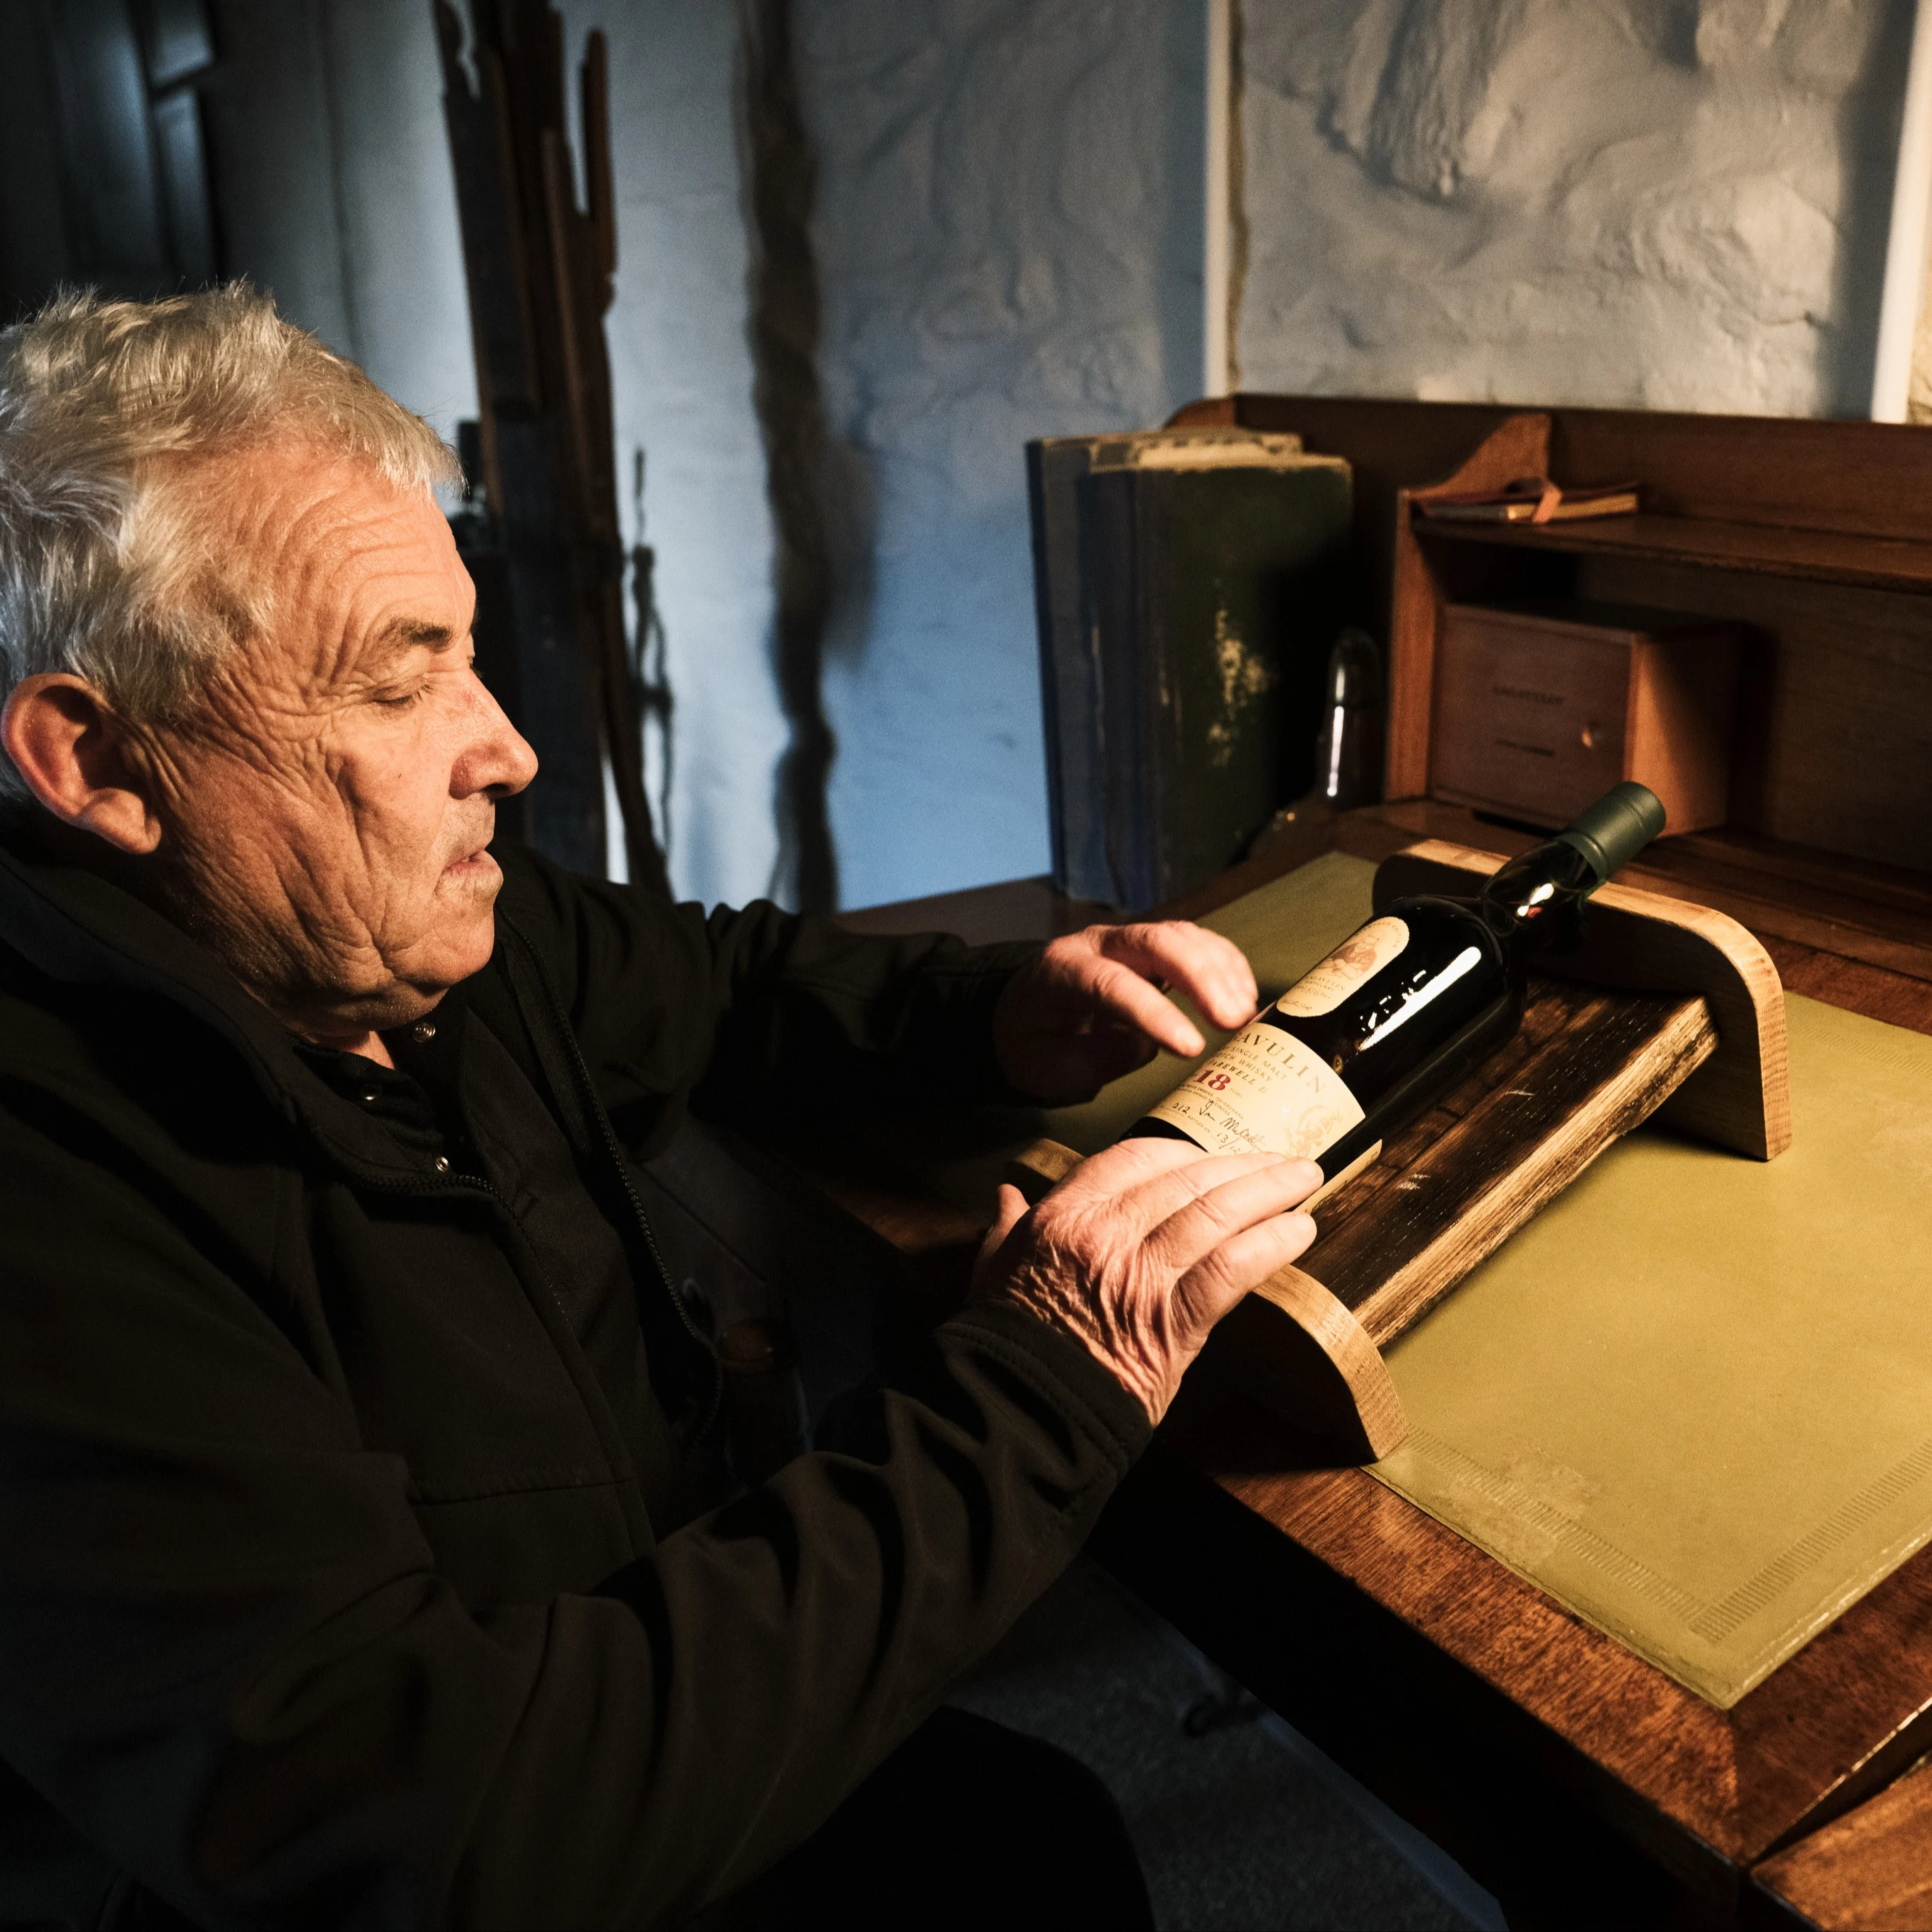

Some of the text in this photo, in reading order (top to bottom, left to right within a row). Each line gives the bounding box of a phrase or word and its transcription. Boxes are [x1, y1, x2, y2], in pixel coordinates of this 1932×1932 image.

[1231, 1046, 1287, 1080] SINGLE MALT
[1239, 1059, 1272, 1082] WHISKY
[1193, 1070, 1231, 1090] 18
